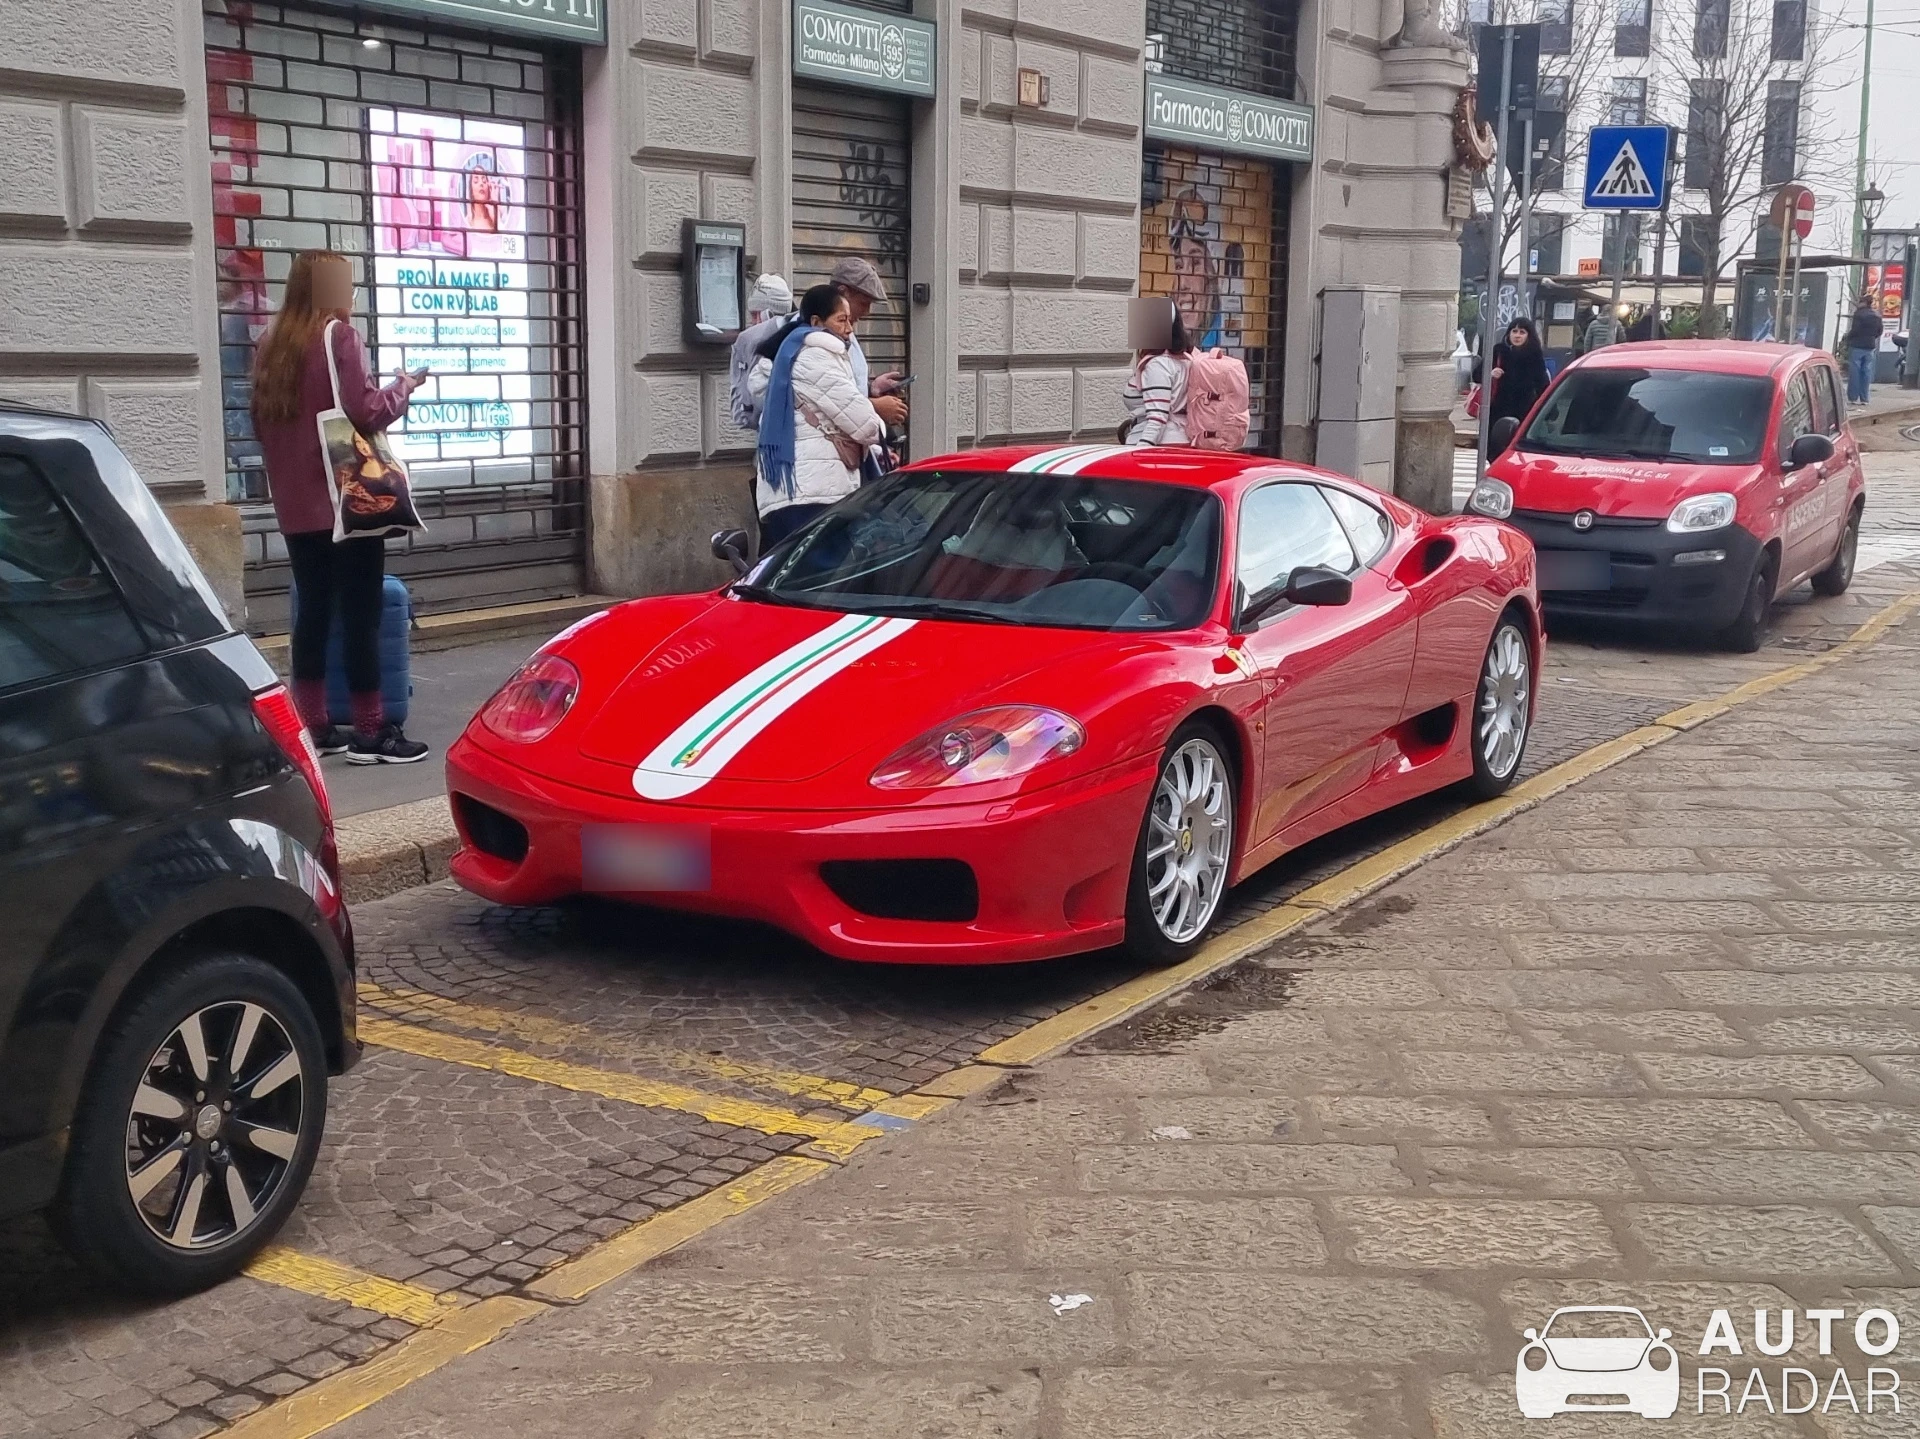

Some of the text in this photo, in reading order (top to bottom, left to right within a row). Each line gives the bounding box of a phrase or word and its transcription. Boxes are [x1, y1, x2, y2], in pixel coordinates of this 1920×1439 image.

[803, 13, 879, 52] COMOTTI
[803, 44, 880, 72] Farmacia Milano
[882, 43, 903, 62] 1595
[1153, 91, 1309, 146] Farmacia COMOTTI
[1580, 263, 1597, 271] TAXI
[450, 271, 490, 287] MAKE
[411, 292, 443, 310] CON
[393, 322, 428, 335] Servizio
[407, 402, 487, 424] COMOTTI
[489, 413, 510, 426] 1595
